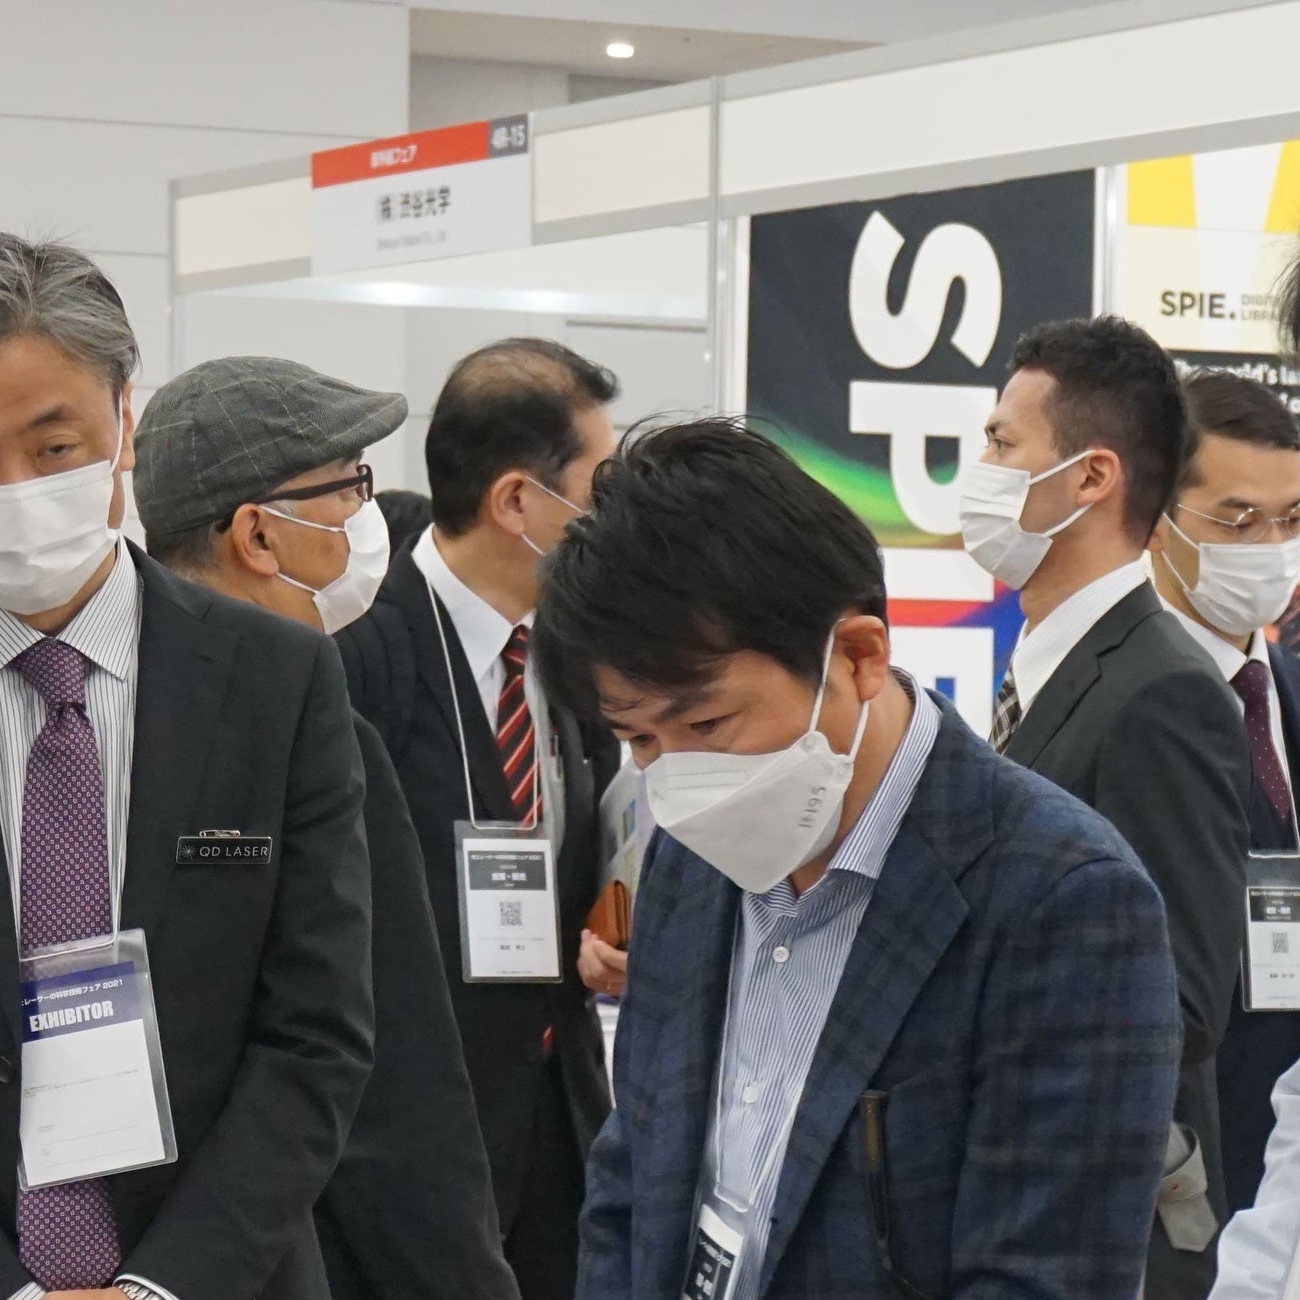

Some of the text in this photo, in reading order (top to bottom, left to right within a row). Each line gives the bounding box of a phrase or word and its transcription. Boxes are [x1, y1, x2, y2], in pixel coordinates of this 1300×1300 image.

[1160, 290, 1236, 320] SPIE.
[199, 846, 269, 857] QD LASER
[28, 1000, 115, 1033] EXHIBITOR
